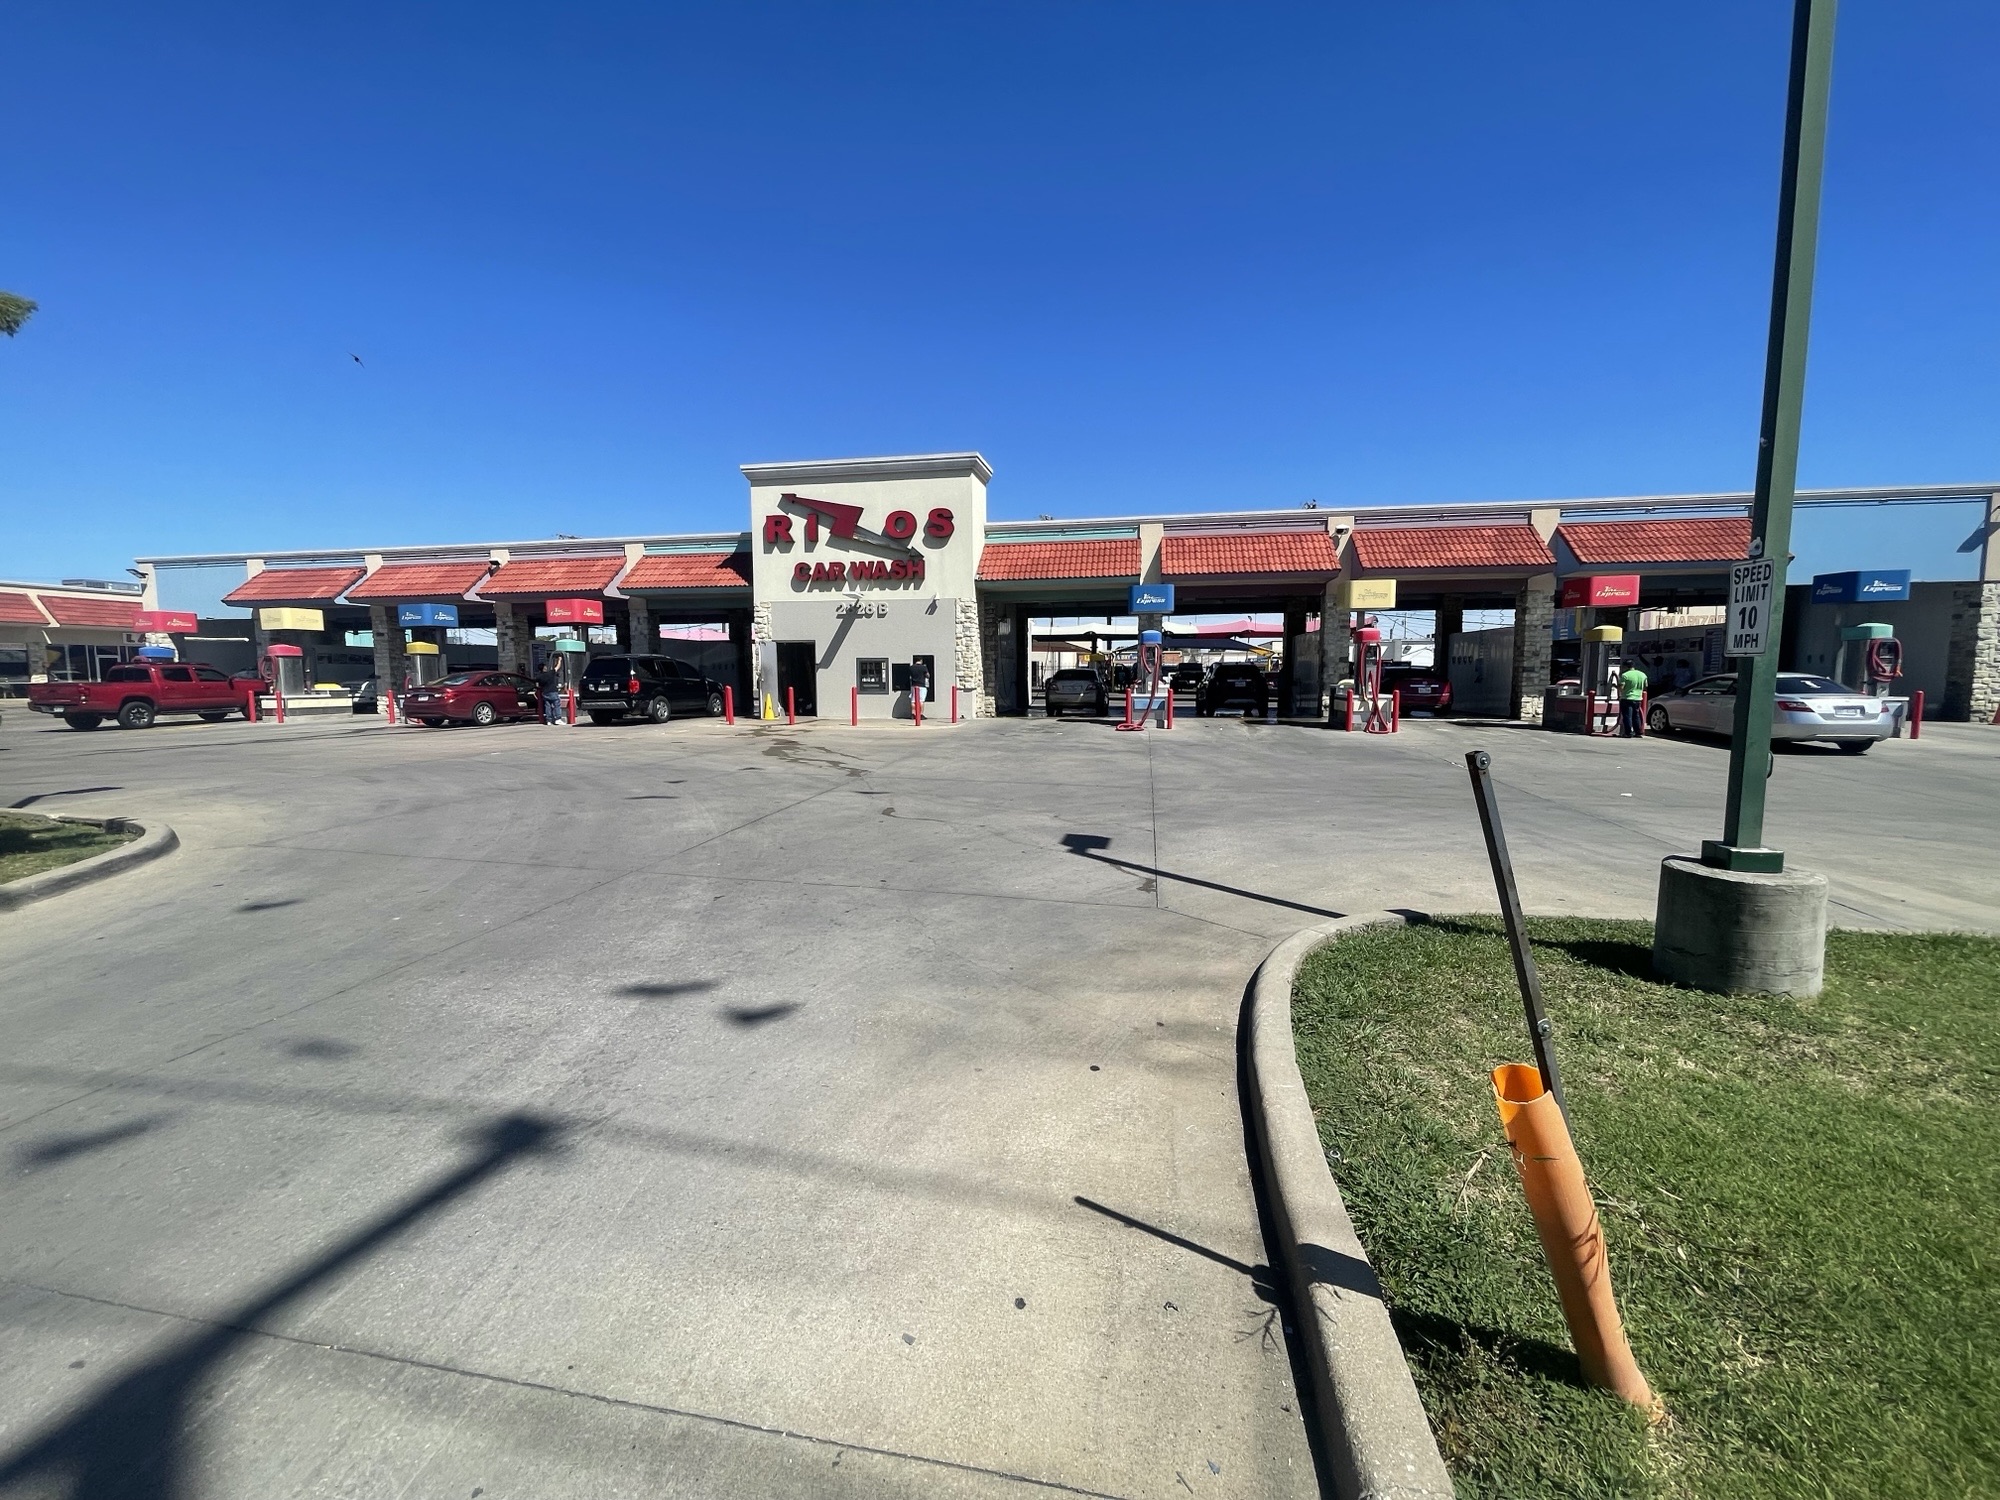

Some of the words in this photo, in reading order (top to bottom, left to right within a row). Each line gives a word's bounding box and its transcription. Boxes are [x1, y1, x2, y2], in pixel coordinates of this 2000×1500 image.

[765, 493, 955, 558] RIZOS
[793, 561, 846, 582] CAR
[849, 559, 926, 581] WASH
[1733, 563, 1772, 585] SPEED
[1734, 583, 1769, 603] LIMIT
[877, 602, 888, 615] B
[1738, 605, 1758, 630] 10
[1733, 633, 1759, 648] MPH
